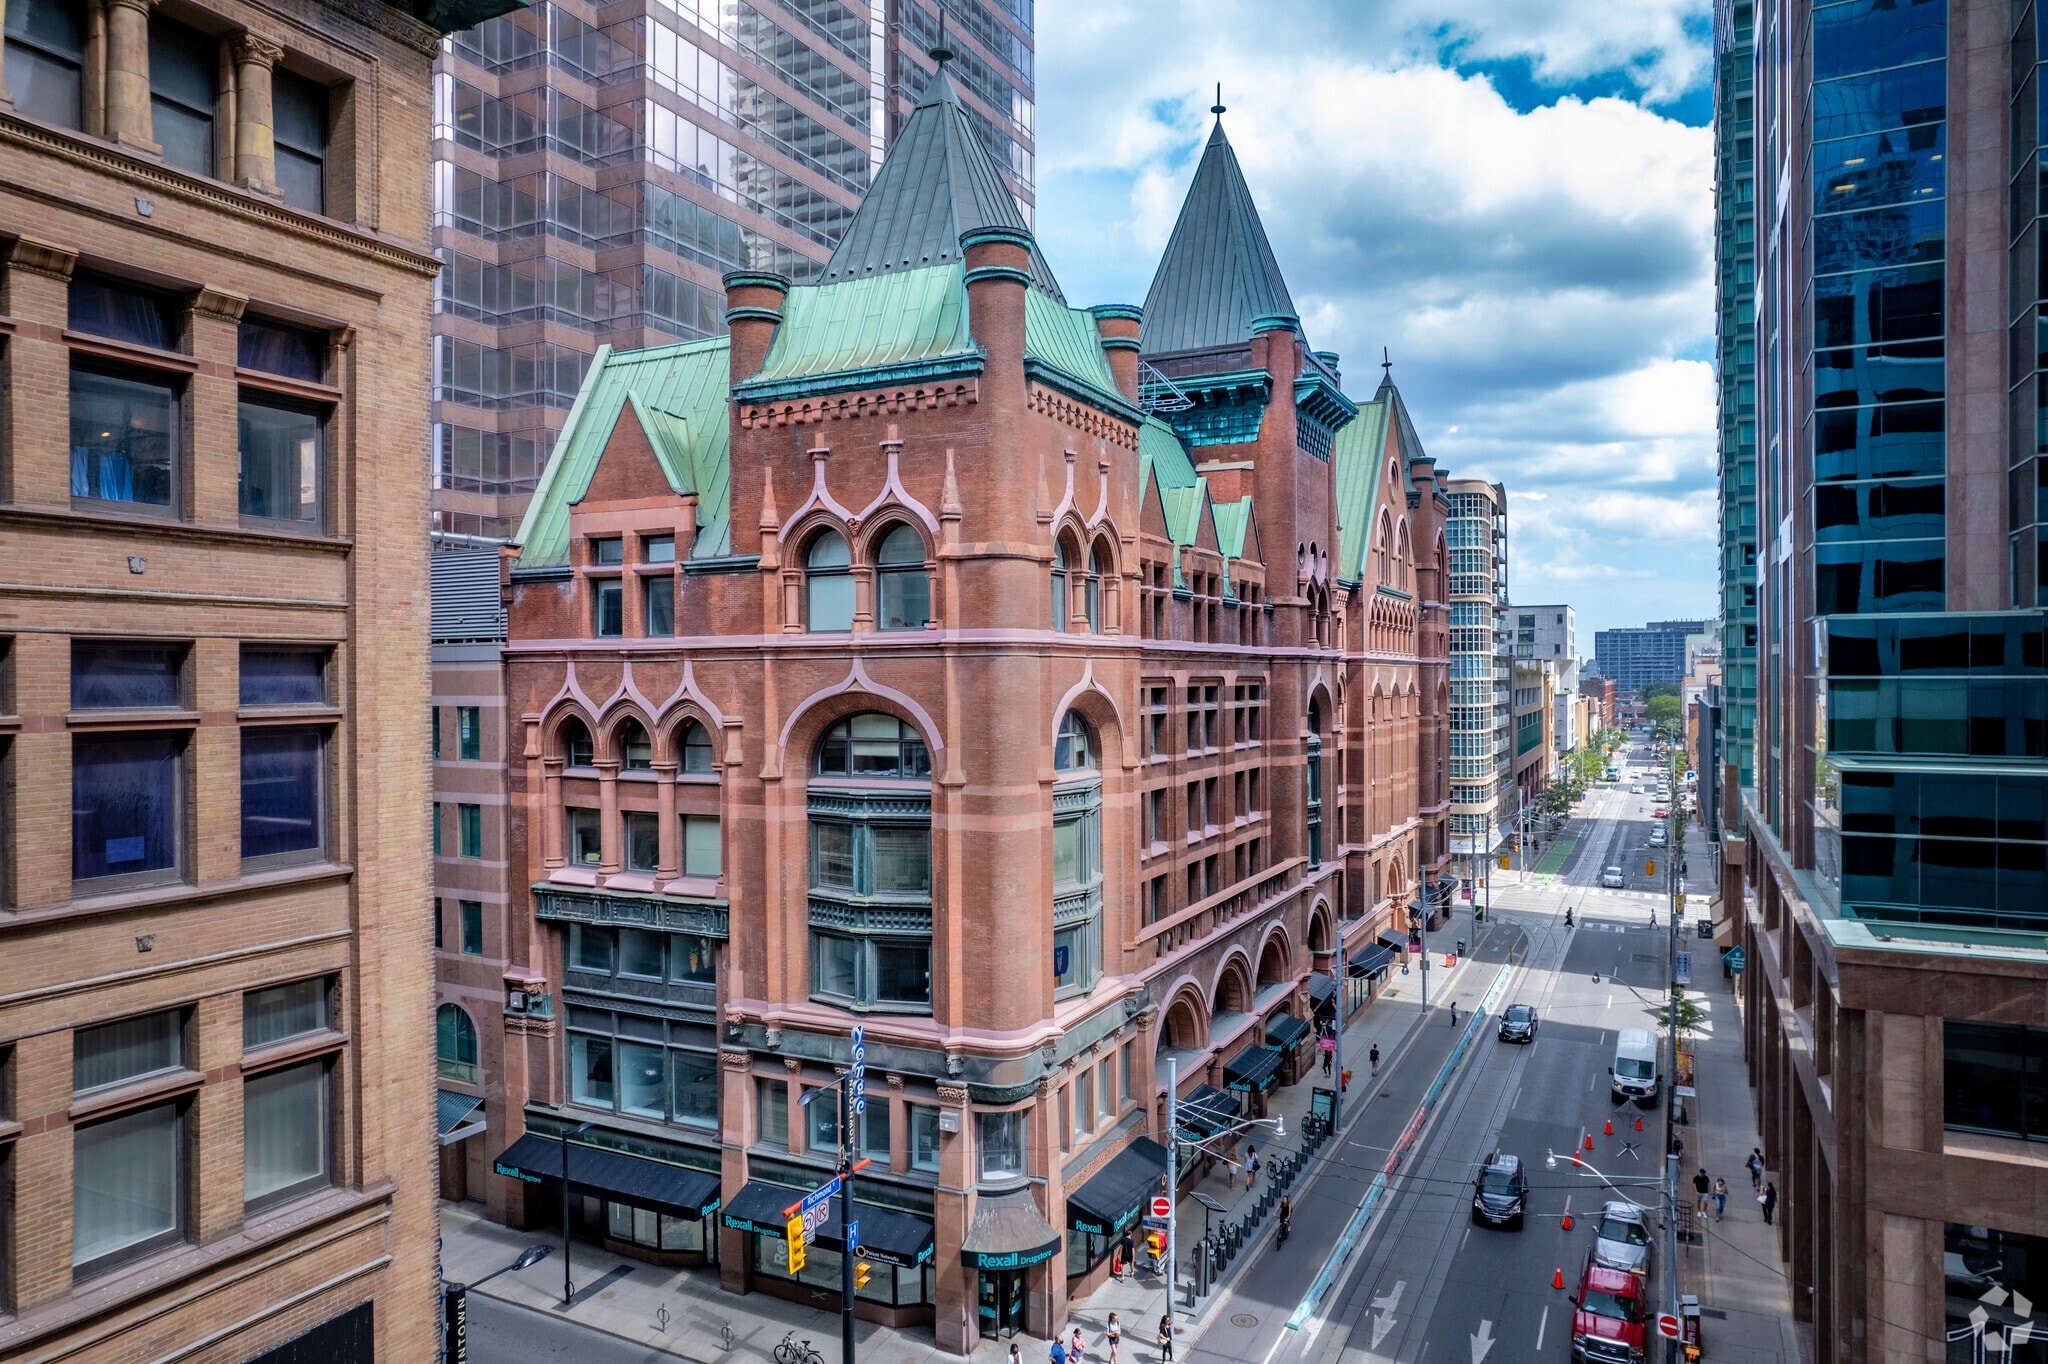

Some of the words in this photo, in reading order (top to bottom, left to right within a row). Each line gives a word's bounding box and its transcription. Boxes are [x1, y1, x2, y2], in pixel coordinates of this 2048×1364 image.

[1687, 772, 1694, 780] P
[852, 1025, 865, 1115] Yonge
[497, 1163, 519, 1178] Rexall
[807, 1185, 832, 1206] Richmond
[701, 1197, 720, 1217] Rexall
[725, 1215, 752, 1231] Rexall
[753, 1226, 780, 1238] Drugstore
[849, 1224, 857, 1239] H
[1075, 1220, 1102, 1234] Rexall
[918, 1242, 934, 1263] Rexall
[978, 1252, 1018, 1269] Rexall
[1020, 1249, 1053, 1265] Drugstore
[457, 1298, 466, 1364] NTOWN
